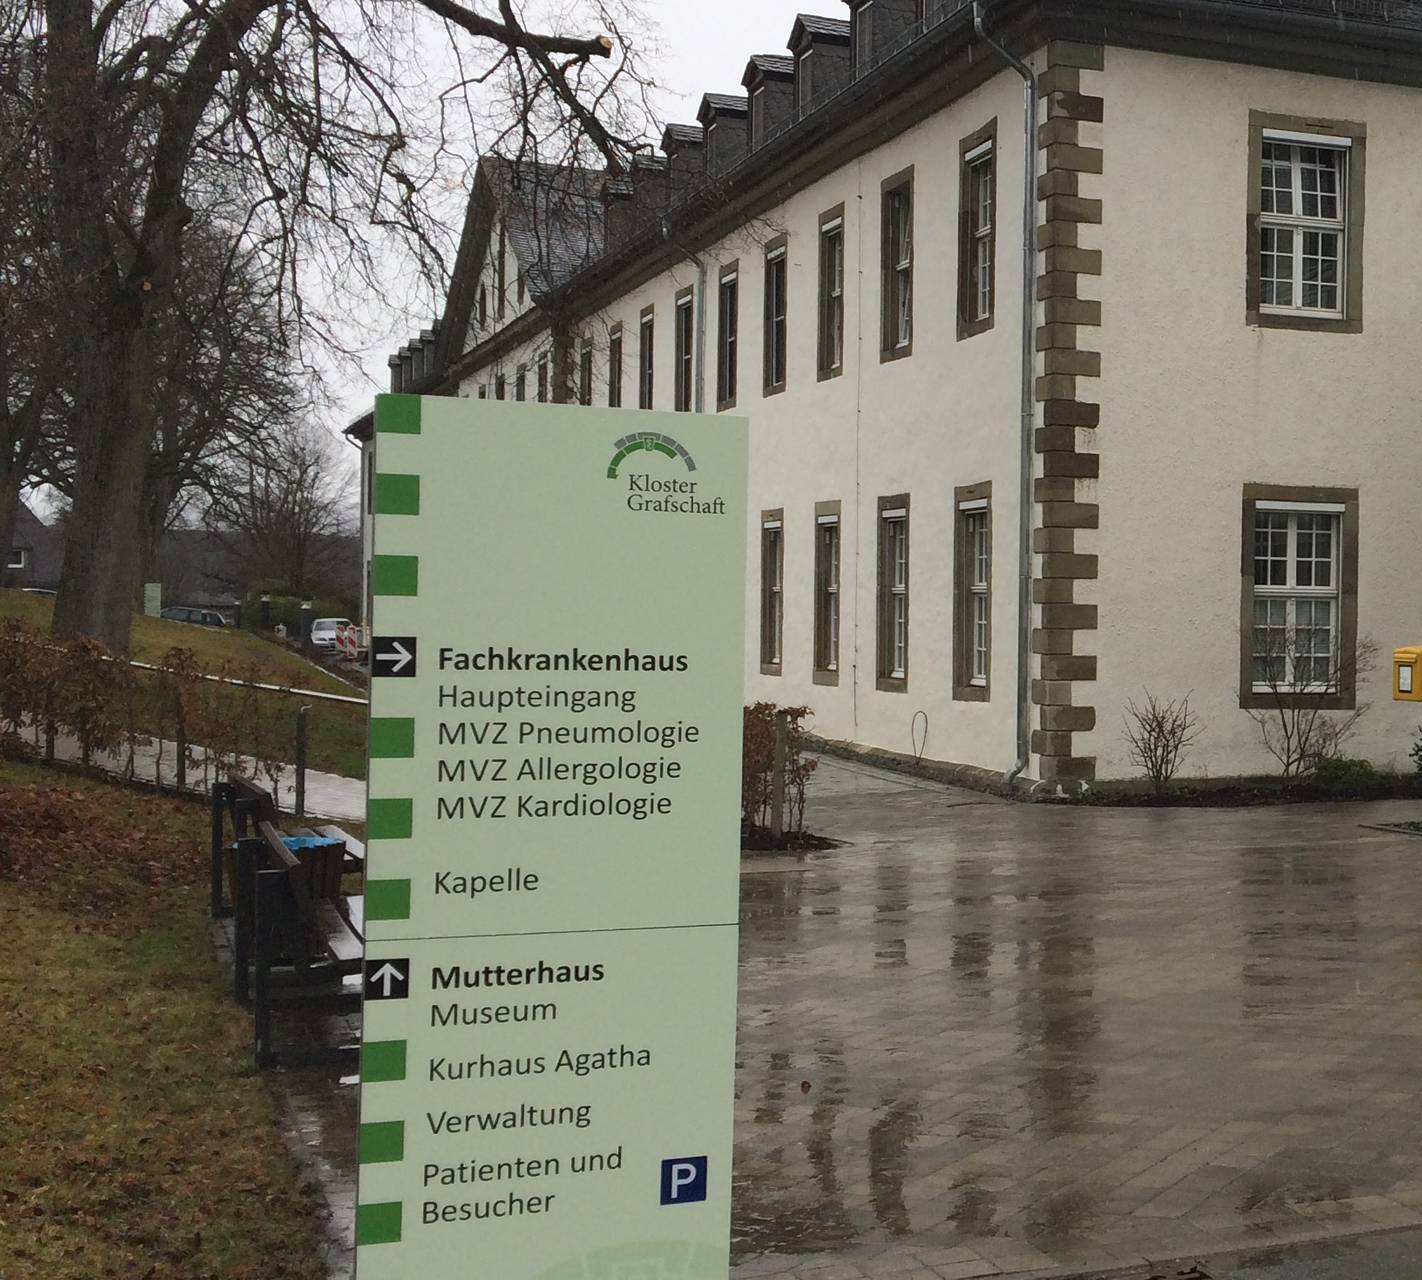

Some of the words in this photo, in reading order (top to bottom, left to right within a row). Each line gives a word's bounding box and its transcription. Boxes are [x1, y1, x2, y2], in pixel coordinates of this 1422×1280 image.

[629, 474, 697, 493] Kloster
[627, 494, 725, 514] Grafschaft
[439, 647, 688, 671] Fachkrankenhaus
[439, 685, 636, 713] Haupteingang
[439, 722, 508, 745] MVZ
[519, 720, 699, 748] Pneumologie
[438, 759, 507, 782] MVZ
[516, 756, 681, 785] Allergologie
[437, 796, 506, 819] MVZ
[518, 792, 671, 820] Kardiologie
[435, 867, 539, 899] Kapelle
[432, 960, 604, 990] Mutterhaus
[431, 1003, 556, 1027] Museum
[430, 1054, 545, 1081] Kurhaus
[555, 1044, 650, 1076] Agatha
[426, 1104, 591, 1134] Verwaltung
[424, 1158, 559, 1187] Patienten
[571, 1146, 622, 1173] und
[671, 1163, 696, 1198] P
[423, 1192, 555, 1224] Besucher
